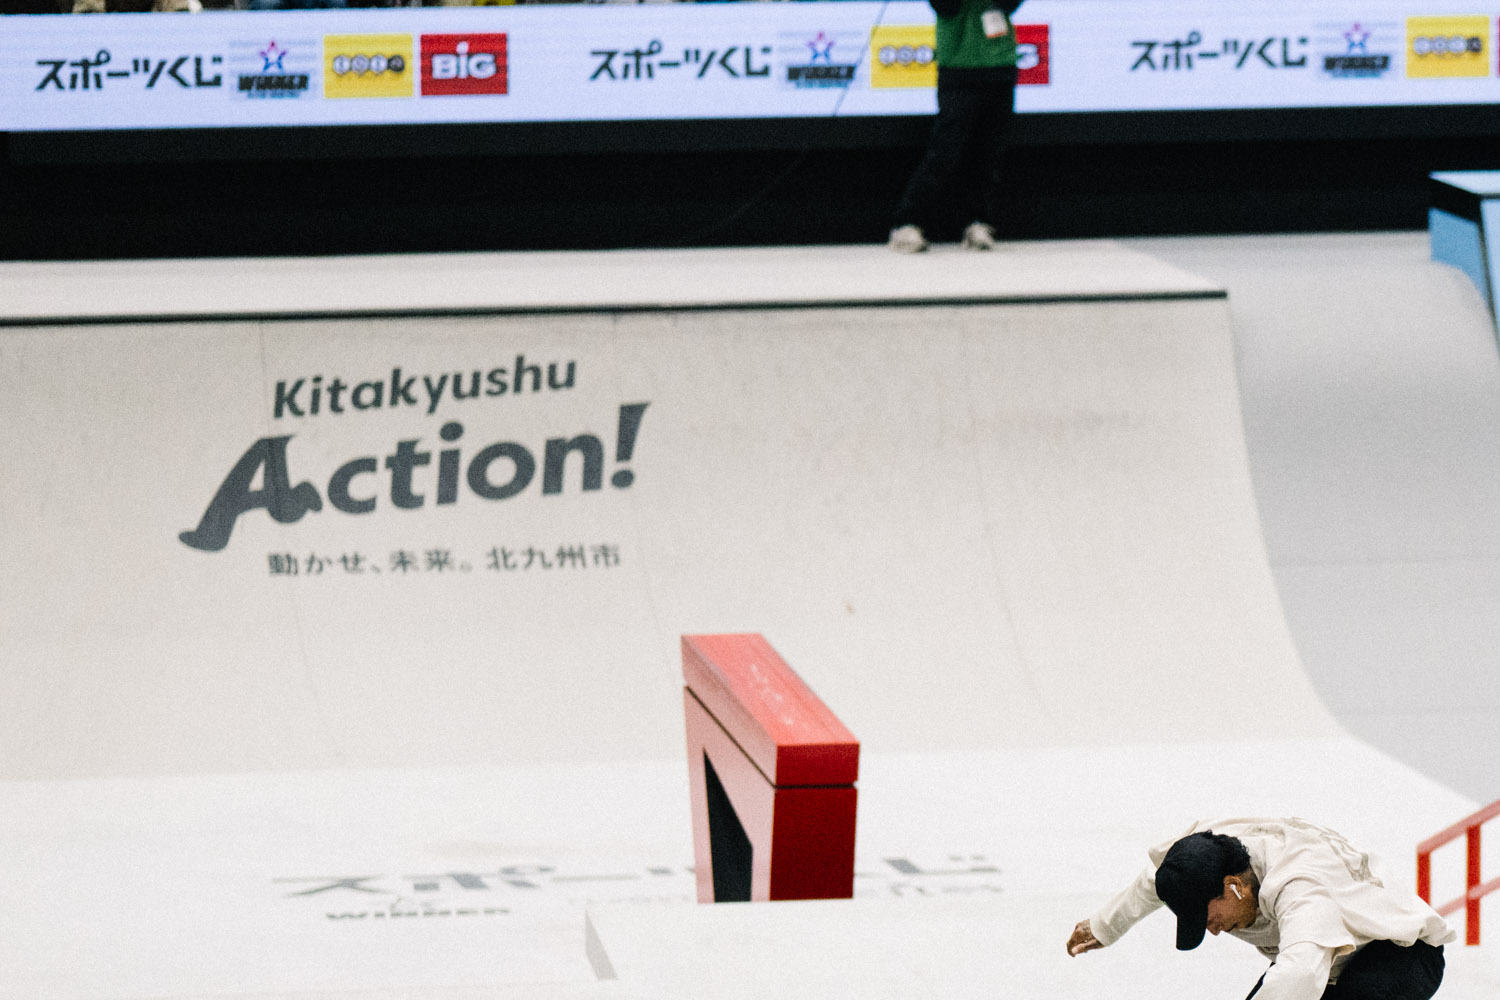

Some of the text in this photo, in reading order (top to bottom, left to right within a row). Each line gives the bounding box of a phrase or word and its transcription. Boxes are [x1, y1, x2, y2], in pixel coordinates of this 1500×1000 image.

[36, 49, 223, 91] スポーツくじ
[590, 40, 771, 80] スポーツくじ
[1130, 31, 1308, 71] スポーツくじ
[273, 354, 577, 420] Kitakyushu
[178, 401, 652, 553] Action!
